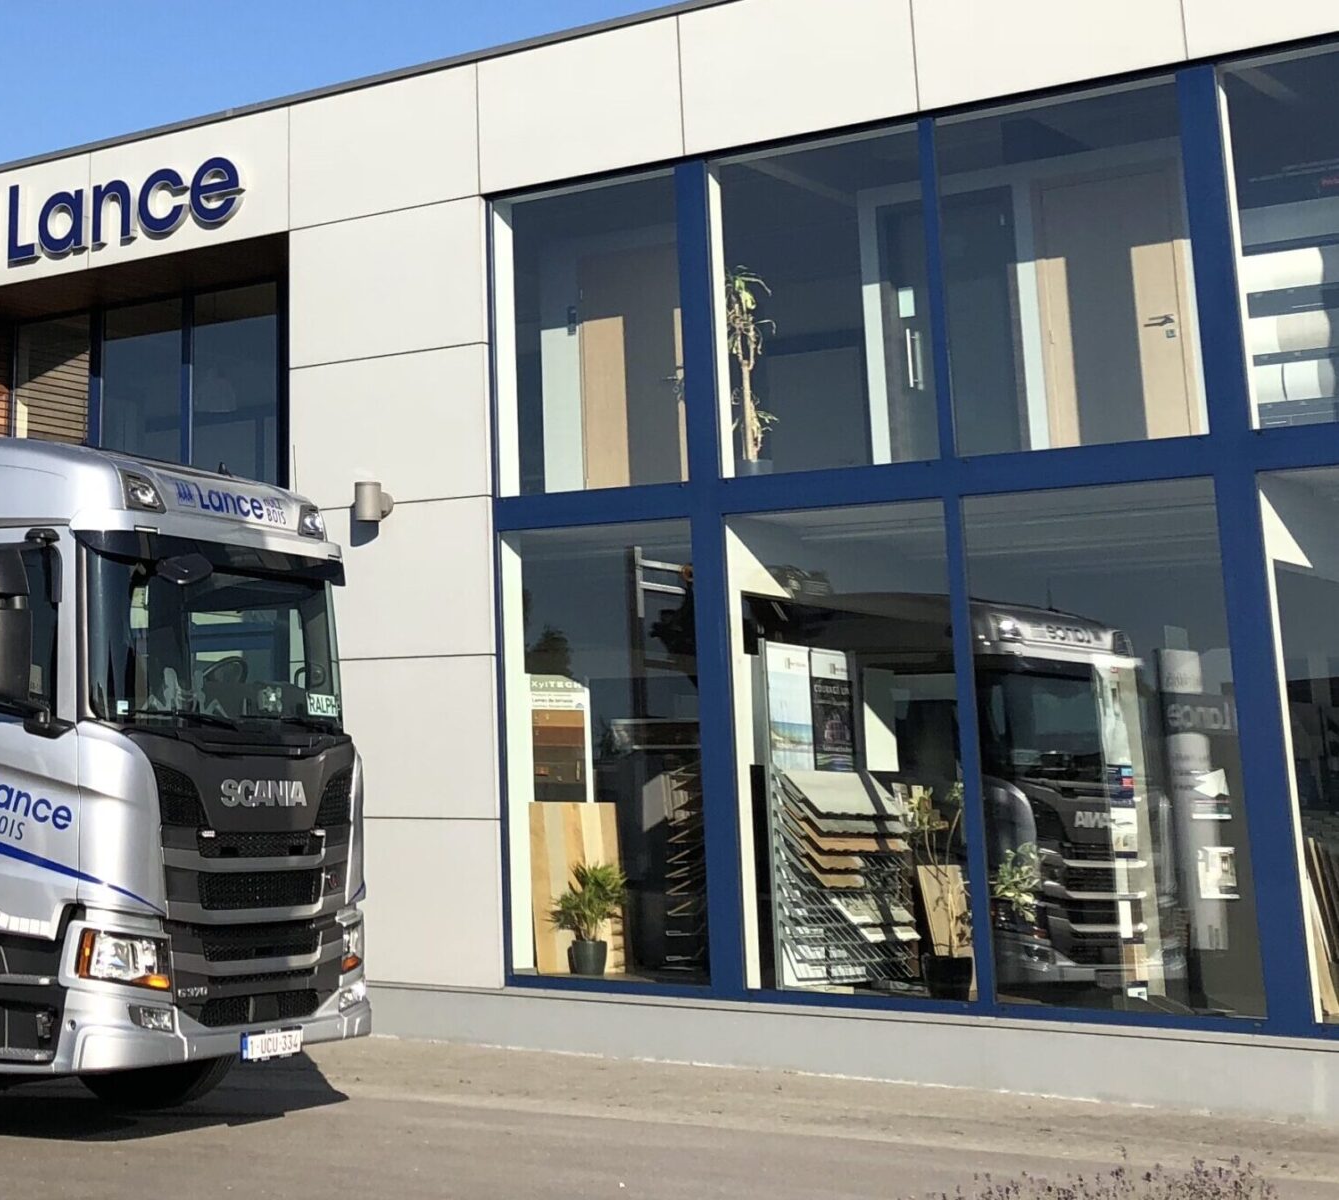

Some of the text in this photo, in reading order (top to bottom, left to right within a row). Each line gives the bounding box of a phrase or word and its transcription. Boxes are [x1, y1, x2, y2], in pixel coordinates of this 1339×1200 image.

[8, 157, 242, 264] Lance
[194, 483, 264, 520] Lance
[266, 509, 287, 525] BOIS
[309, 696, 338, 714] RALPH
[221, 779, 308, 807] SCANIA
